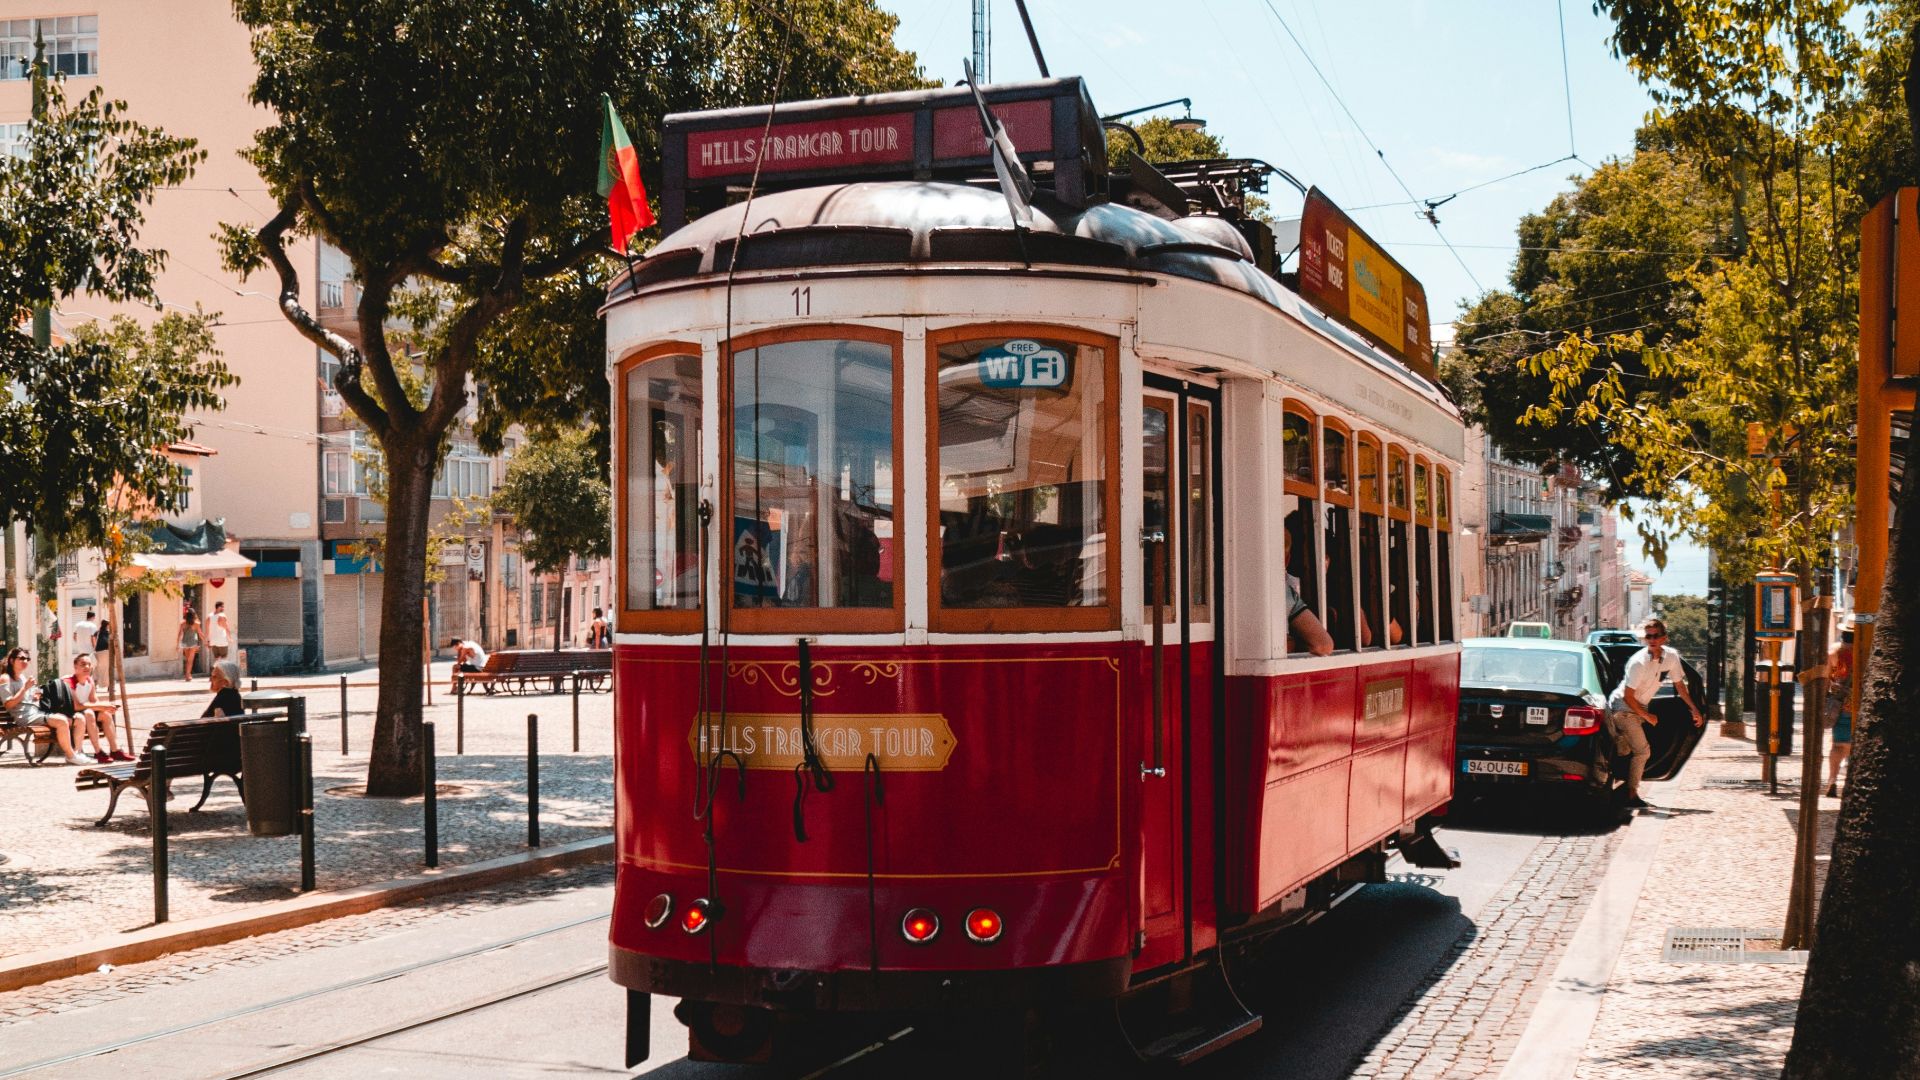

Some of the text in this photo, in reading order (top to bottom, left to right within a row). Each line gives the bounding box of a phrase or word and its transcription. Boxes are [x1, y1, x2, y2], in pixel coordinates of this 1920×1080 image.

[702, 126, 898, 166] HILLS TRAMCAR TOUR
[1326, 229, 1344, 261] TICKETS
[1327, 262, 1343, 291] INSIDE
[791, 286, 811, 316] 11
[1011, 343, 1034, 352] FREE
[869, 727, 935, 757] TOUR
